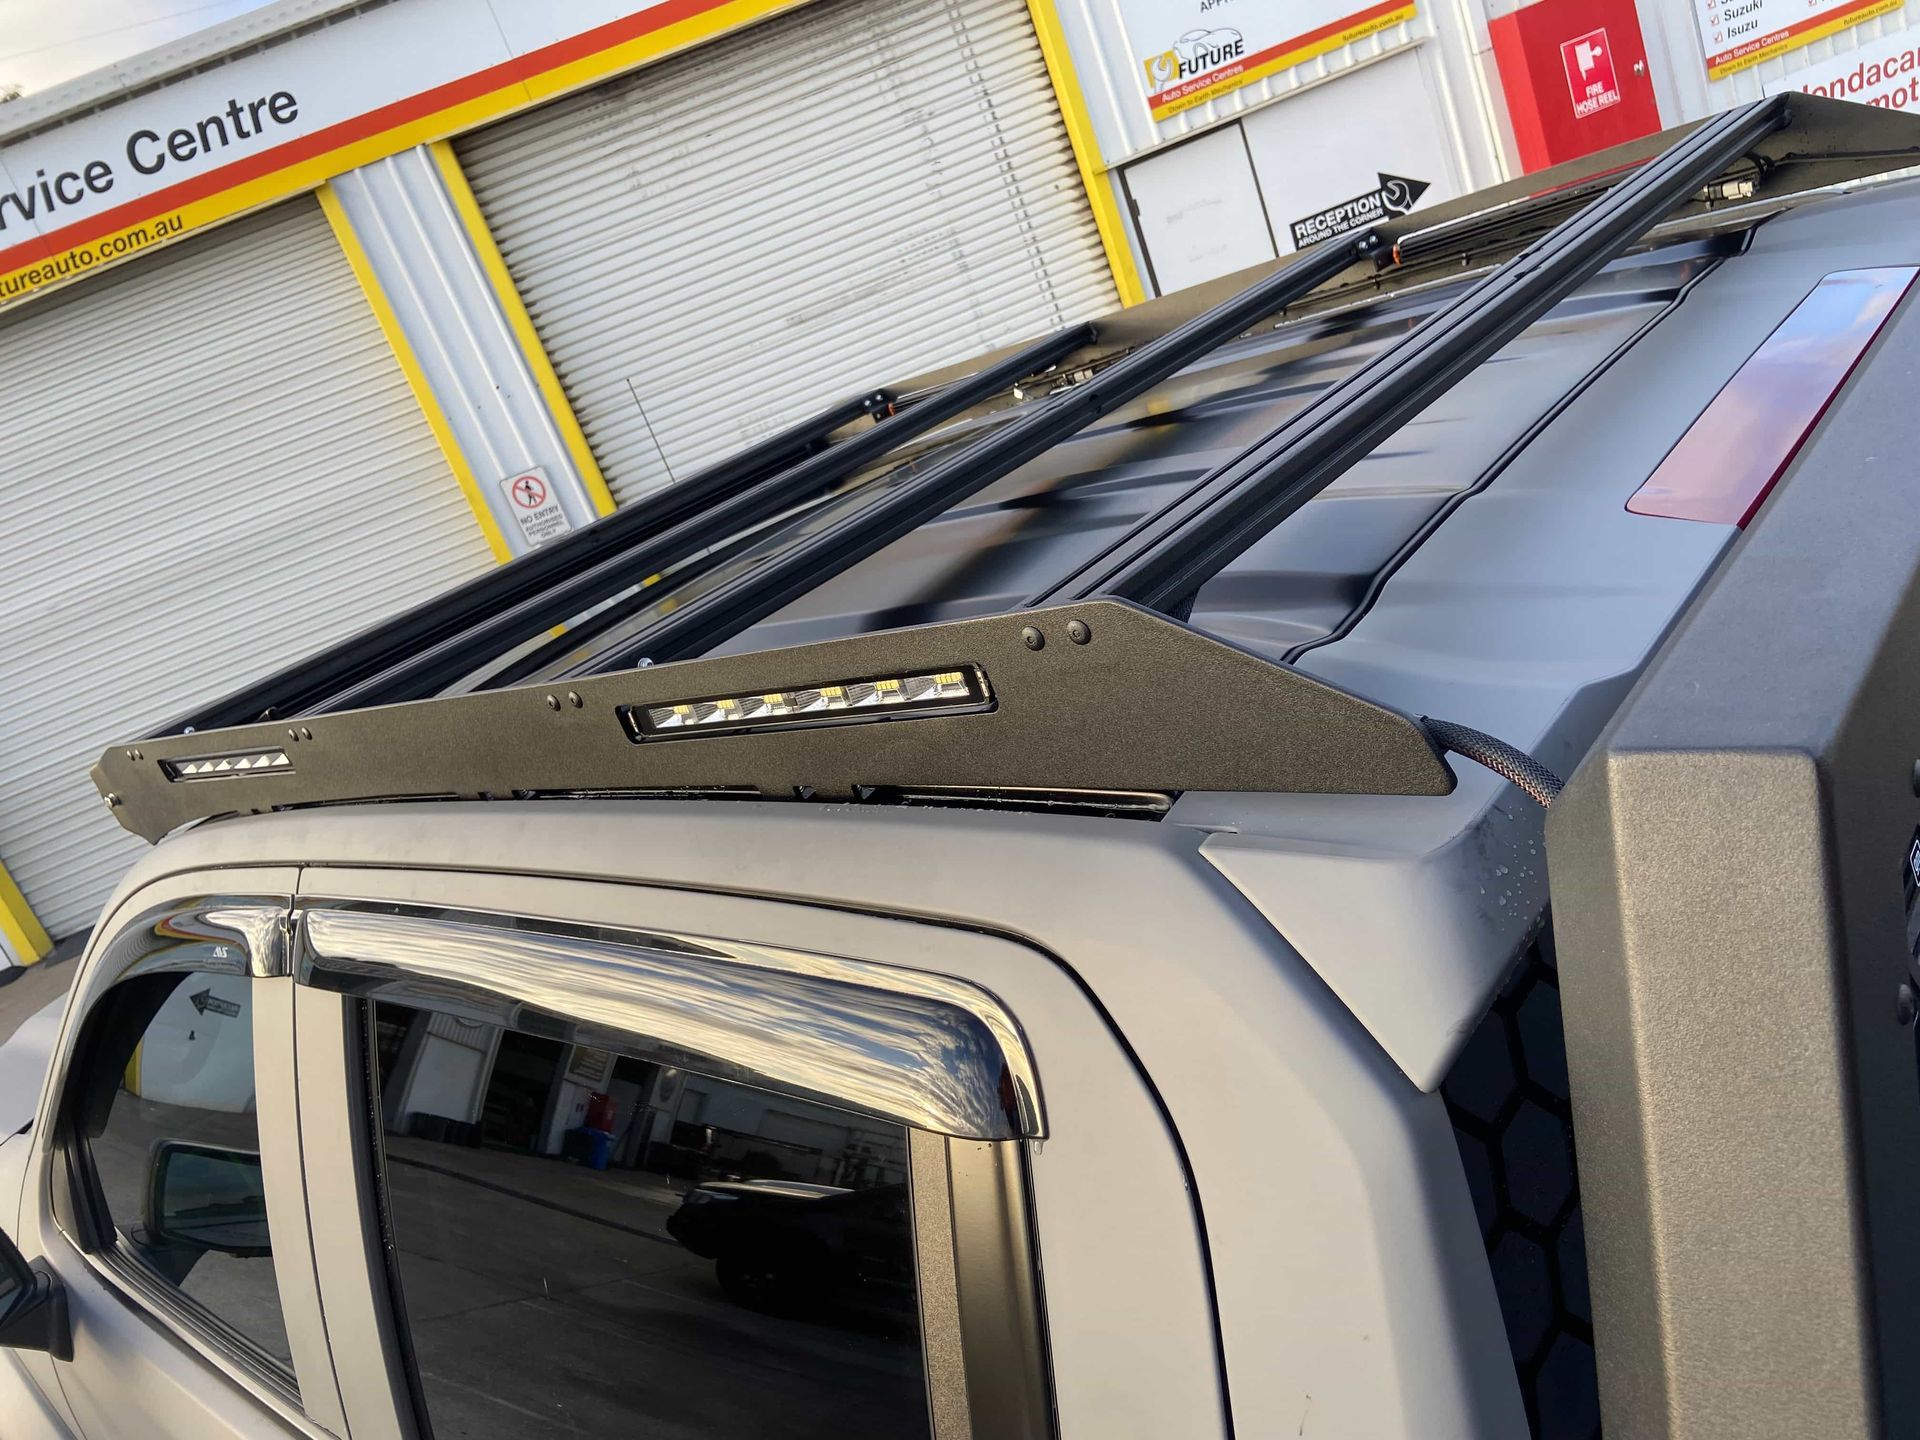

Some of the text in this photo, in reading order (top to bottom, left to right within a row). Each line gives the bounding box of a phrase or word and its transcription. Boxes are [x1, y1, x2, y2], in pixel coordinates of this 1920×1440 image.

[1724, 0, 1763, 21] Suzuki
[1727, 19, 1758, 38] Isuzu
[1179, 39, 1244, 79] FUTURE
[1715, 31, 1789, 65] Auto Service Centres
[1162, 65, 1244, 103] Auto Service Centres
[1585, 81, 1604, 98] FIRE
[1576, 97, 1599, 115] HOSE
[0, 91, 298, 231] rvice Centre
[1295, 192, 1381, 238] RECEPTION
[1298, 208, 1384, 248] AROUND THE CORNER
[520, 515, 533, 525] NO
